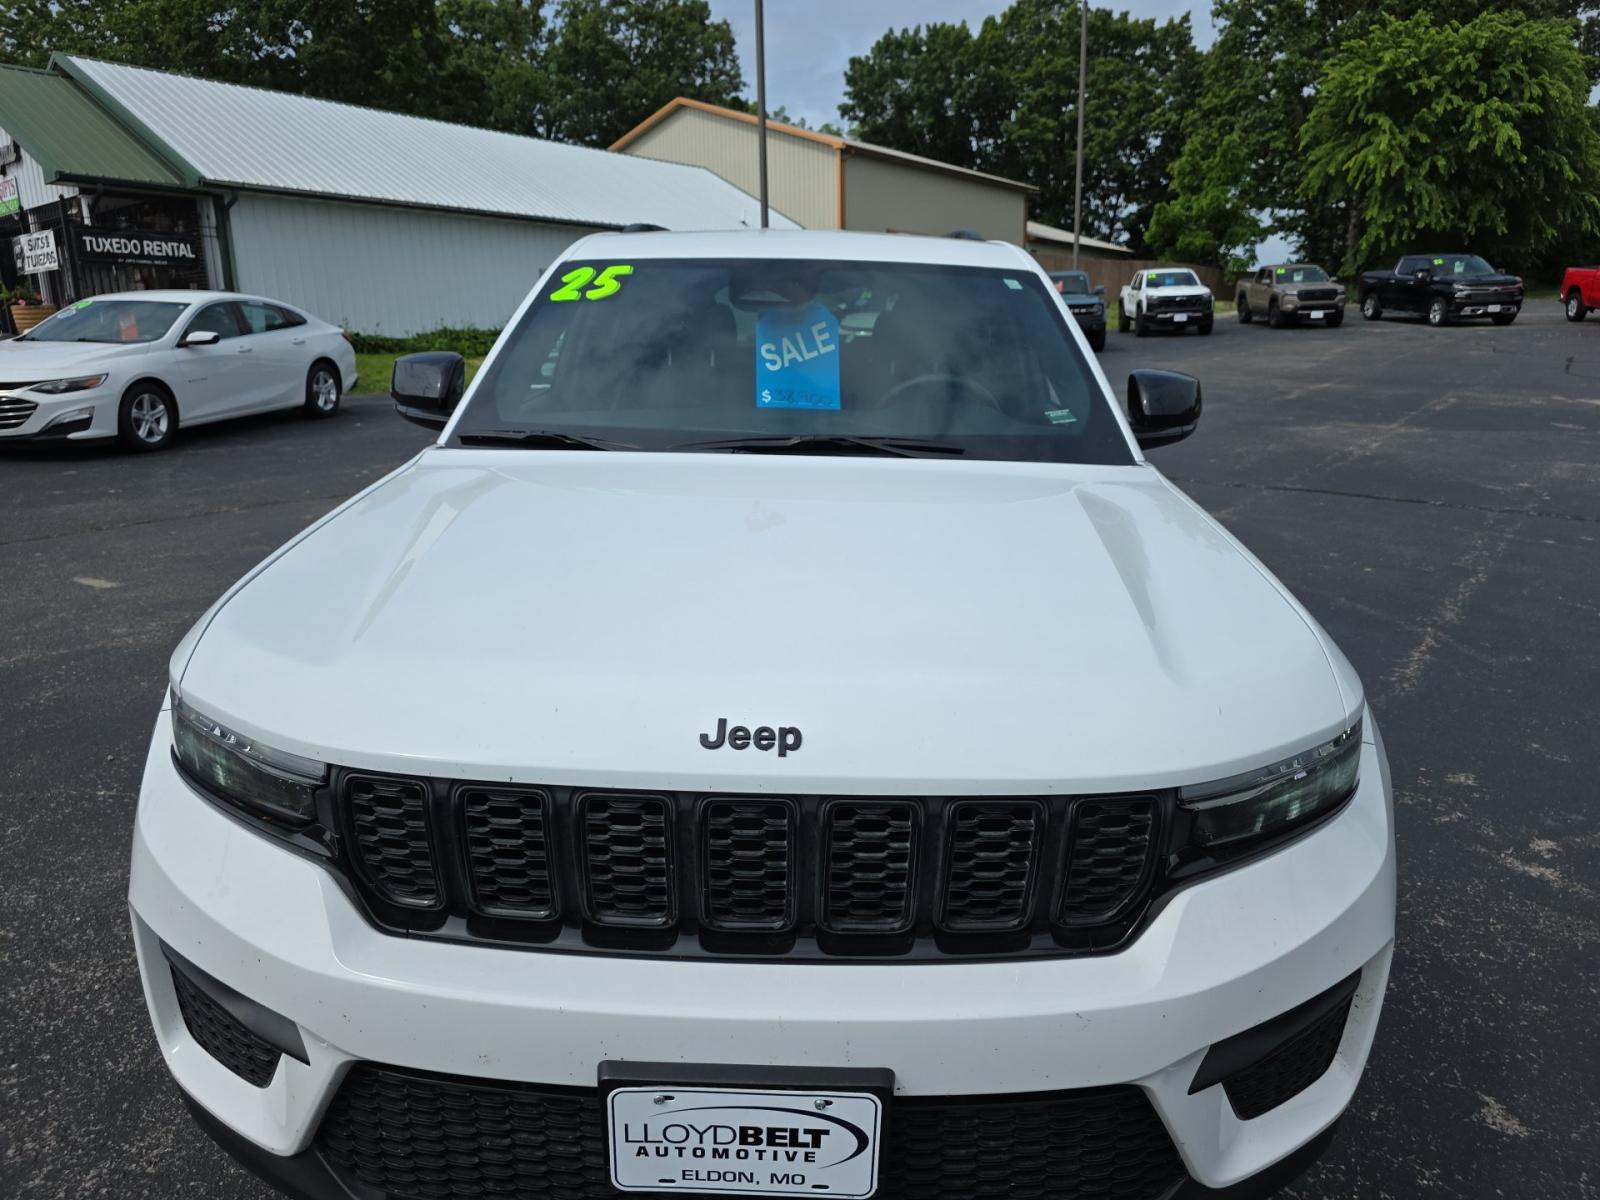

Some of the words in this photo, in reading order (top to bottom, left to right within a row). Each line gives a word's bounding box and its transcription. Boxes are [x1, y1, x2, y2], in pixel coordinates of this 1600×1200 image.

[82, 235, 141, 255] TUXEDO
[143, 239, 196, 259] RENTAL
[549, 264, 635, 302] 25
[760, 321, 836, 372] SALE
[699, 717, 803, 758] Jeep
[635, 1145, 817, 1164] AUTOMOTIVE
[681, 1168, 761, 1186] ELDON,
[770, 1172, 806, 1186] MO
